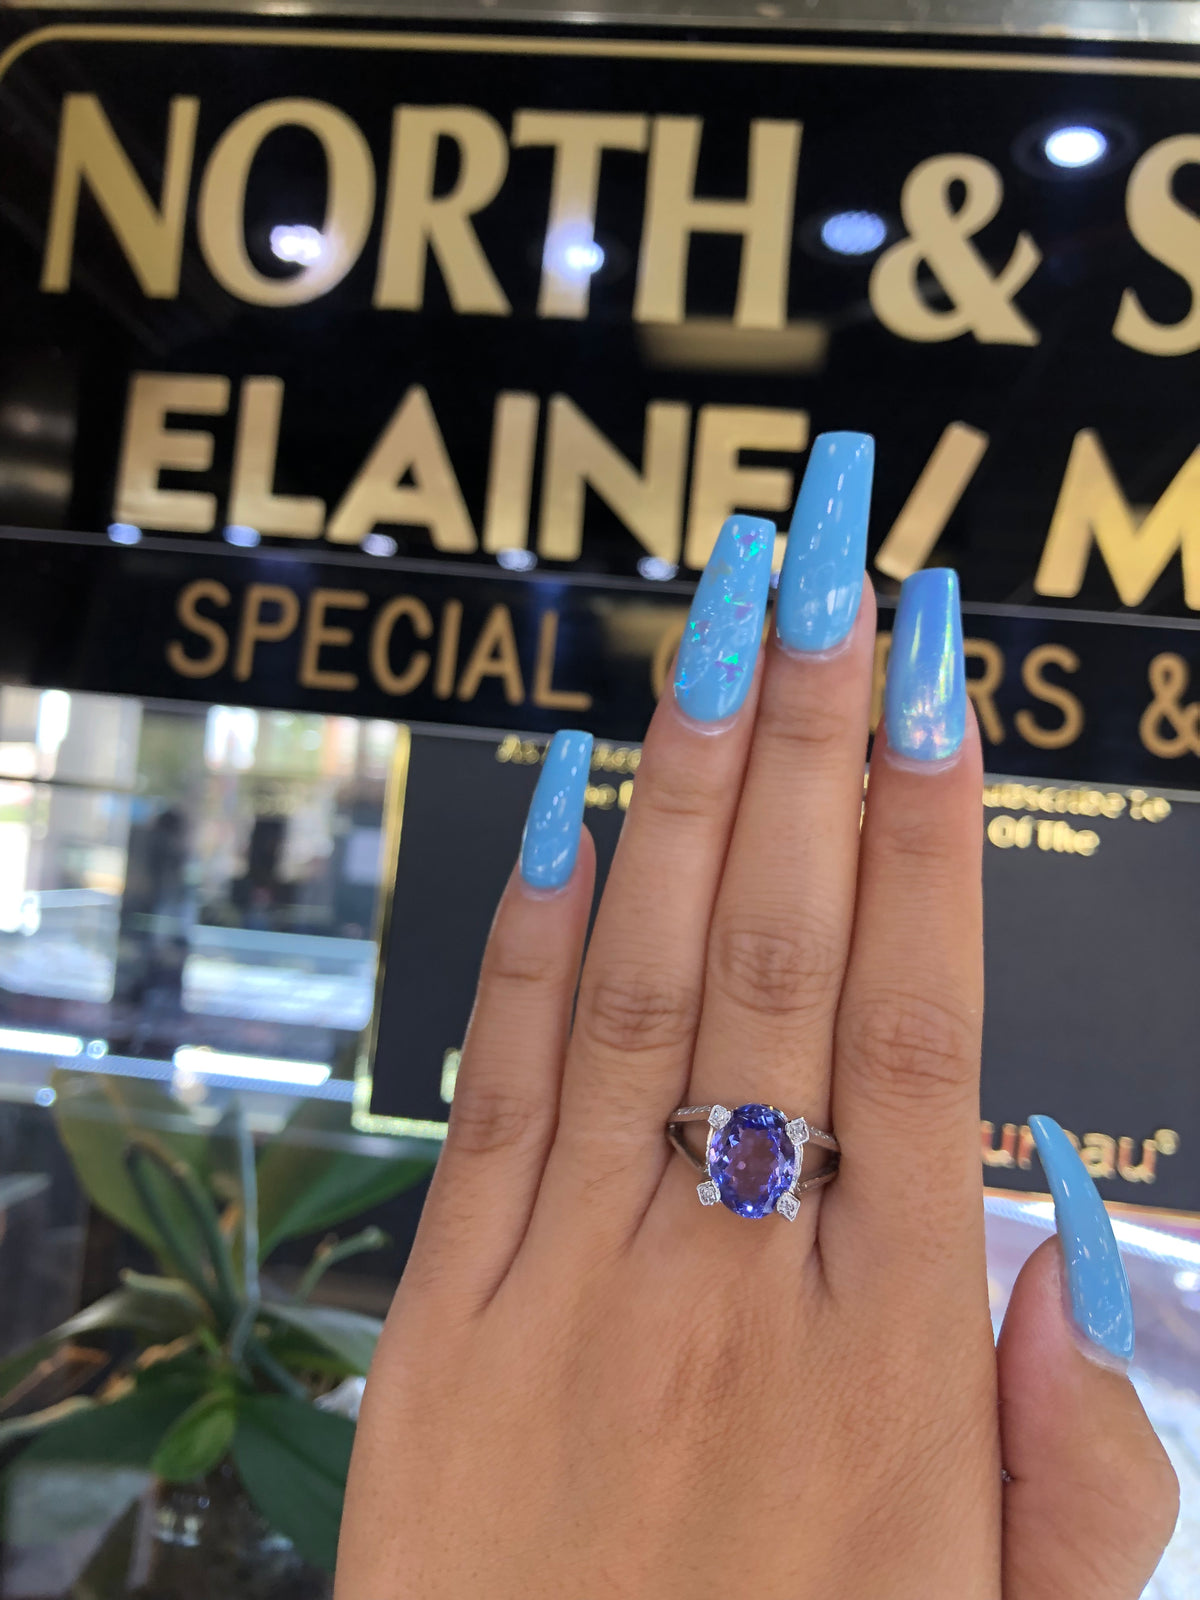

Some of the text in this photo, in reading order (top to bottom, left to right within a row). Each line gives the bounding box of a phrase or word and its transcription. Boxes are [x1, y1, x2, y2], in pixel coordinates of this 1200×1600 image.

[40, 93, 803, 330] NORTH
[869, 153, 1041, 347] &
[112, 371, 810, 571] ELAINE
[166, 579, 593, 710] SPECIAL
